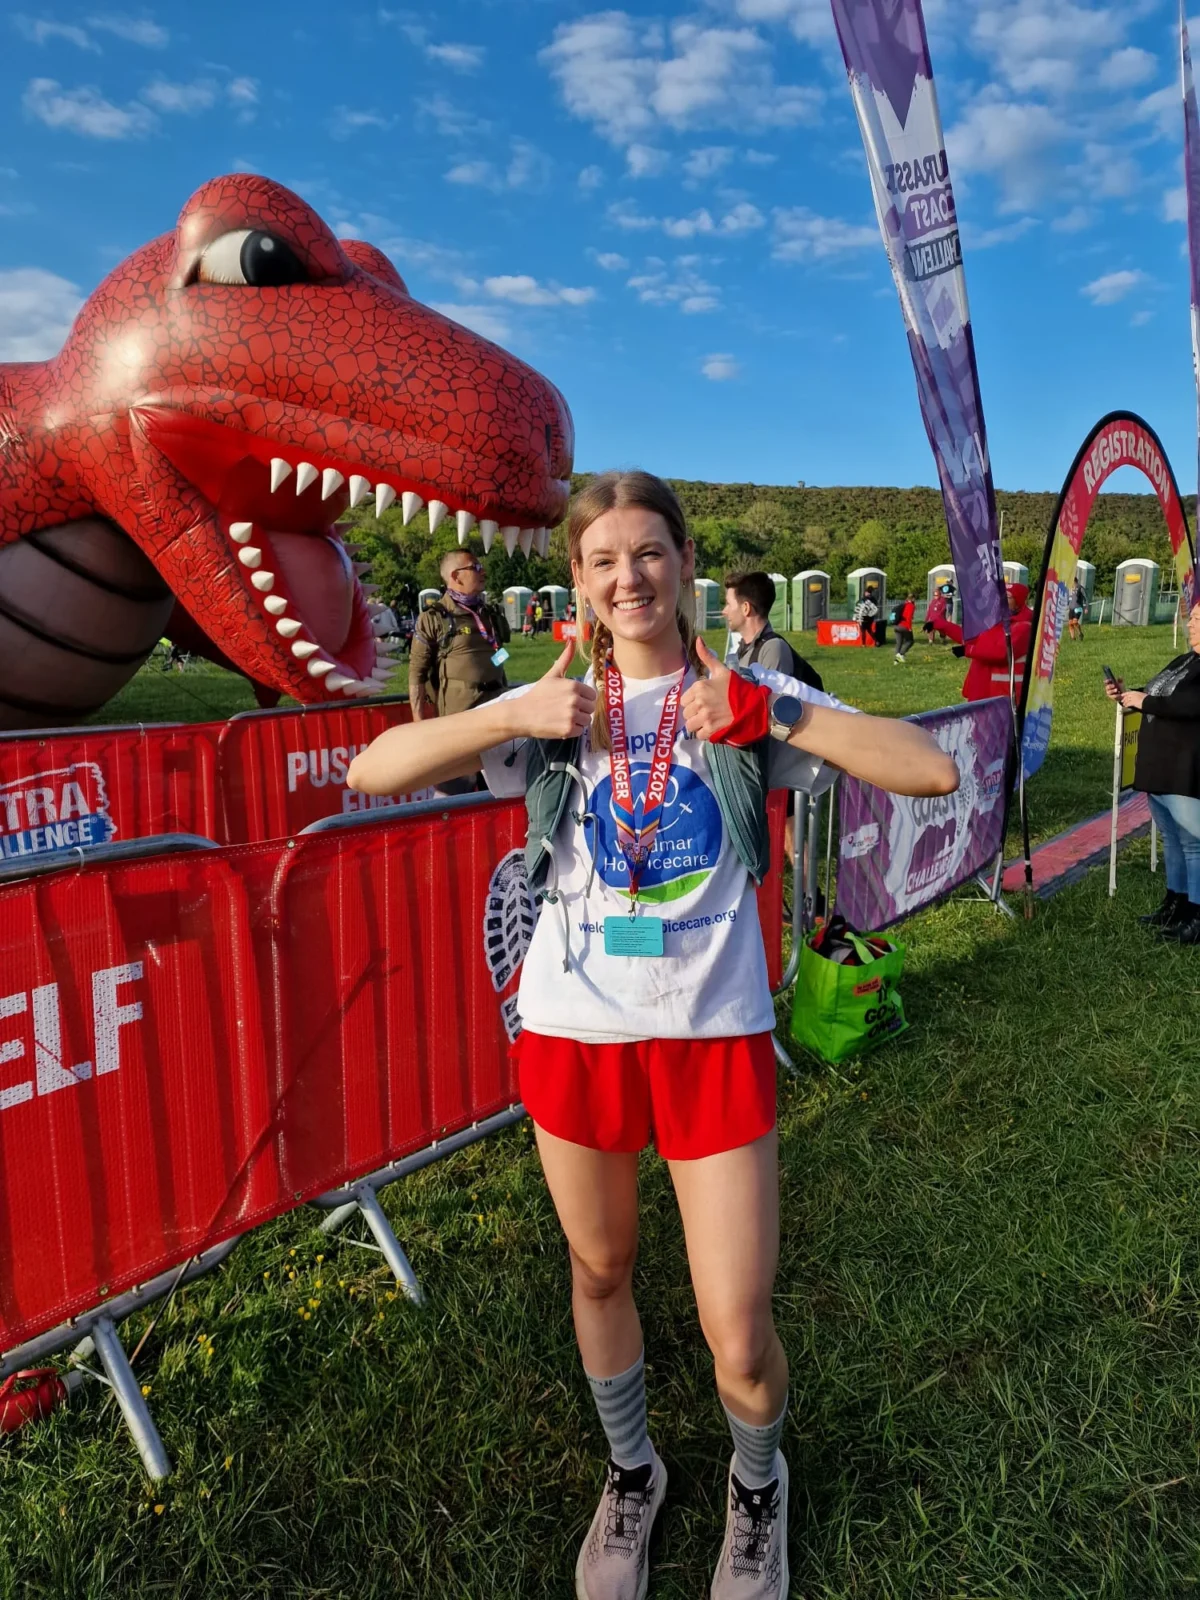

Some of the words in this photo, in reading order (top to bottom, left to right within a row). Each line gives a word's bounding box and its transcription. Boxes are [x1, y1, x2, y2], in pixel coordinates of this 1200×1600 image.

[1083, 430, 1170, 503] REGISTRATION
[608, 670, 622, 705] 2026
[609, 708, 630, 800] CHALLENGER
[648, 761, 668, 802] 2026
[0, 782, 91, 833] TRA
[604, 854, 709, 872] Hoicecare
[0, 961, 143, 1110] ELF
